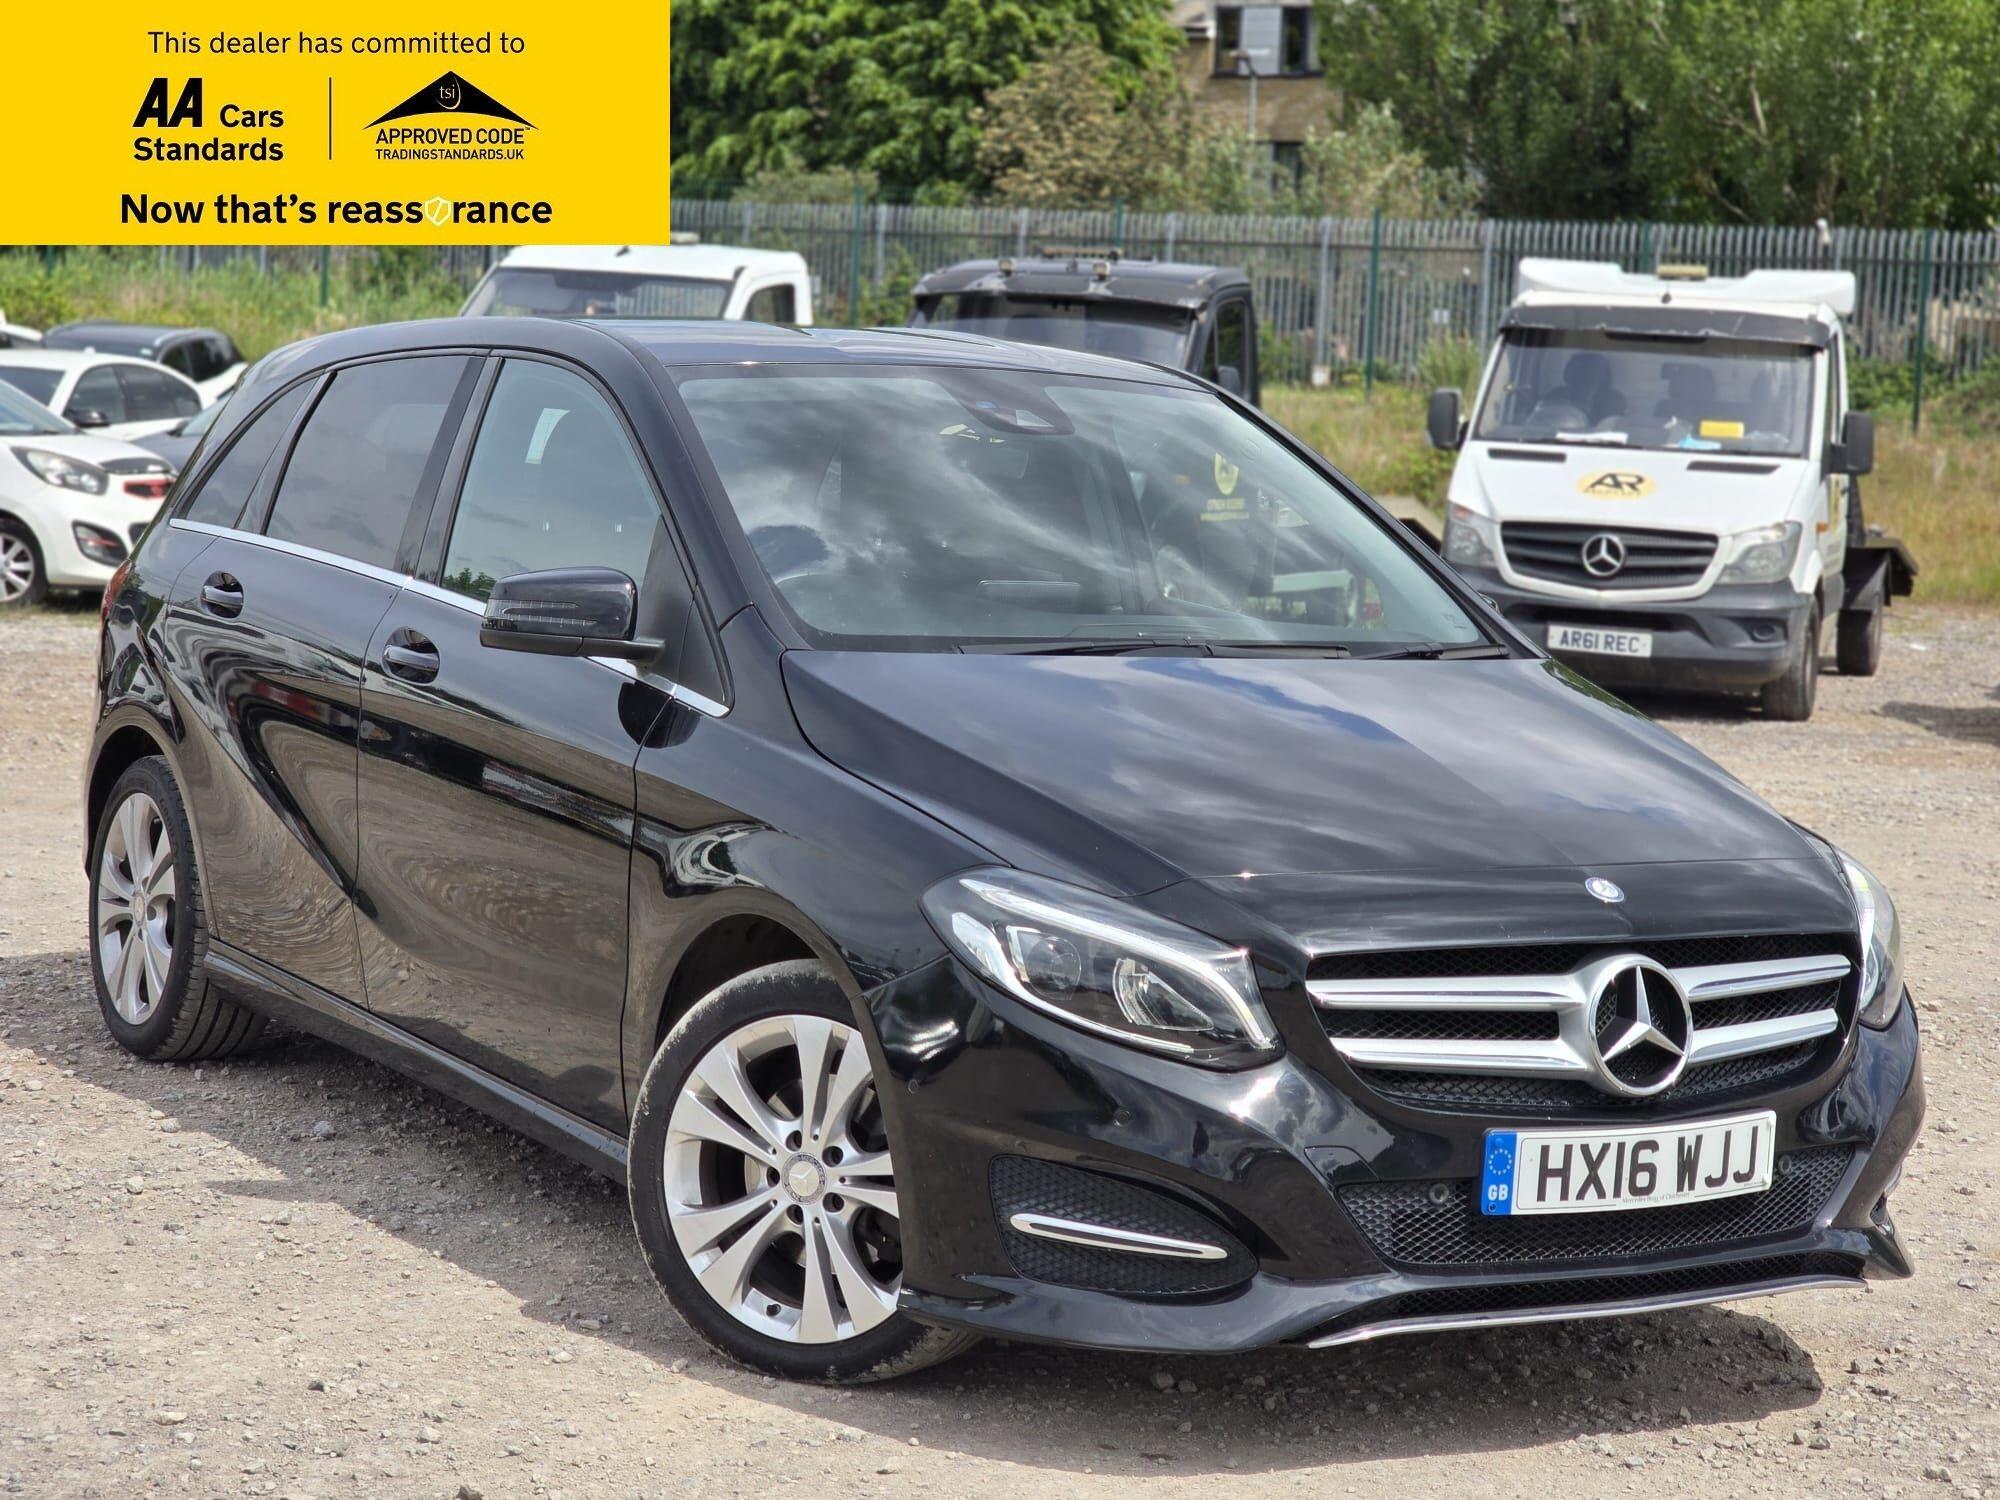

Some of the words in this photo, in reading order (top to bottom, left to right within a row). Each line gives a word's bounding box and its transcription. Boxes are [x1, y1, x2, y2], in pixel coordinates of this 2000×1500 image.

[1588, 472, 1645, 493] AR
[1560, 629, 1600, 650] AR61
[1603, 633, 1640, 653] REC
[1536, 1139, 1660, 1203] HX16
[1676, 1125, 1759, 1193] WJJ
[1487, 1183, 1509, 1202] GB
